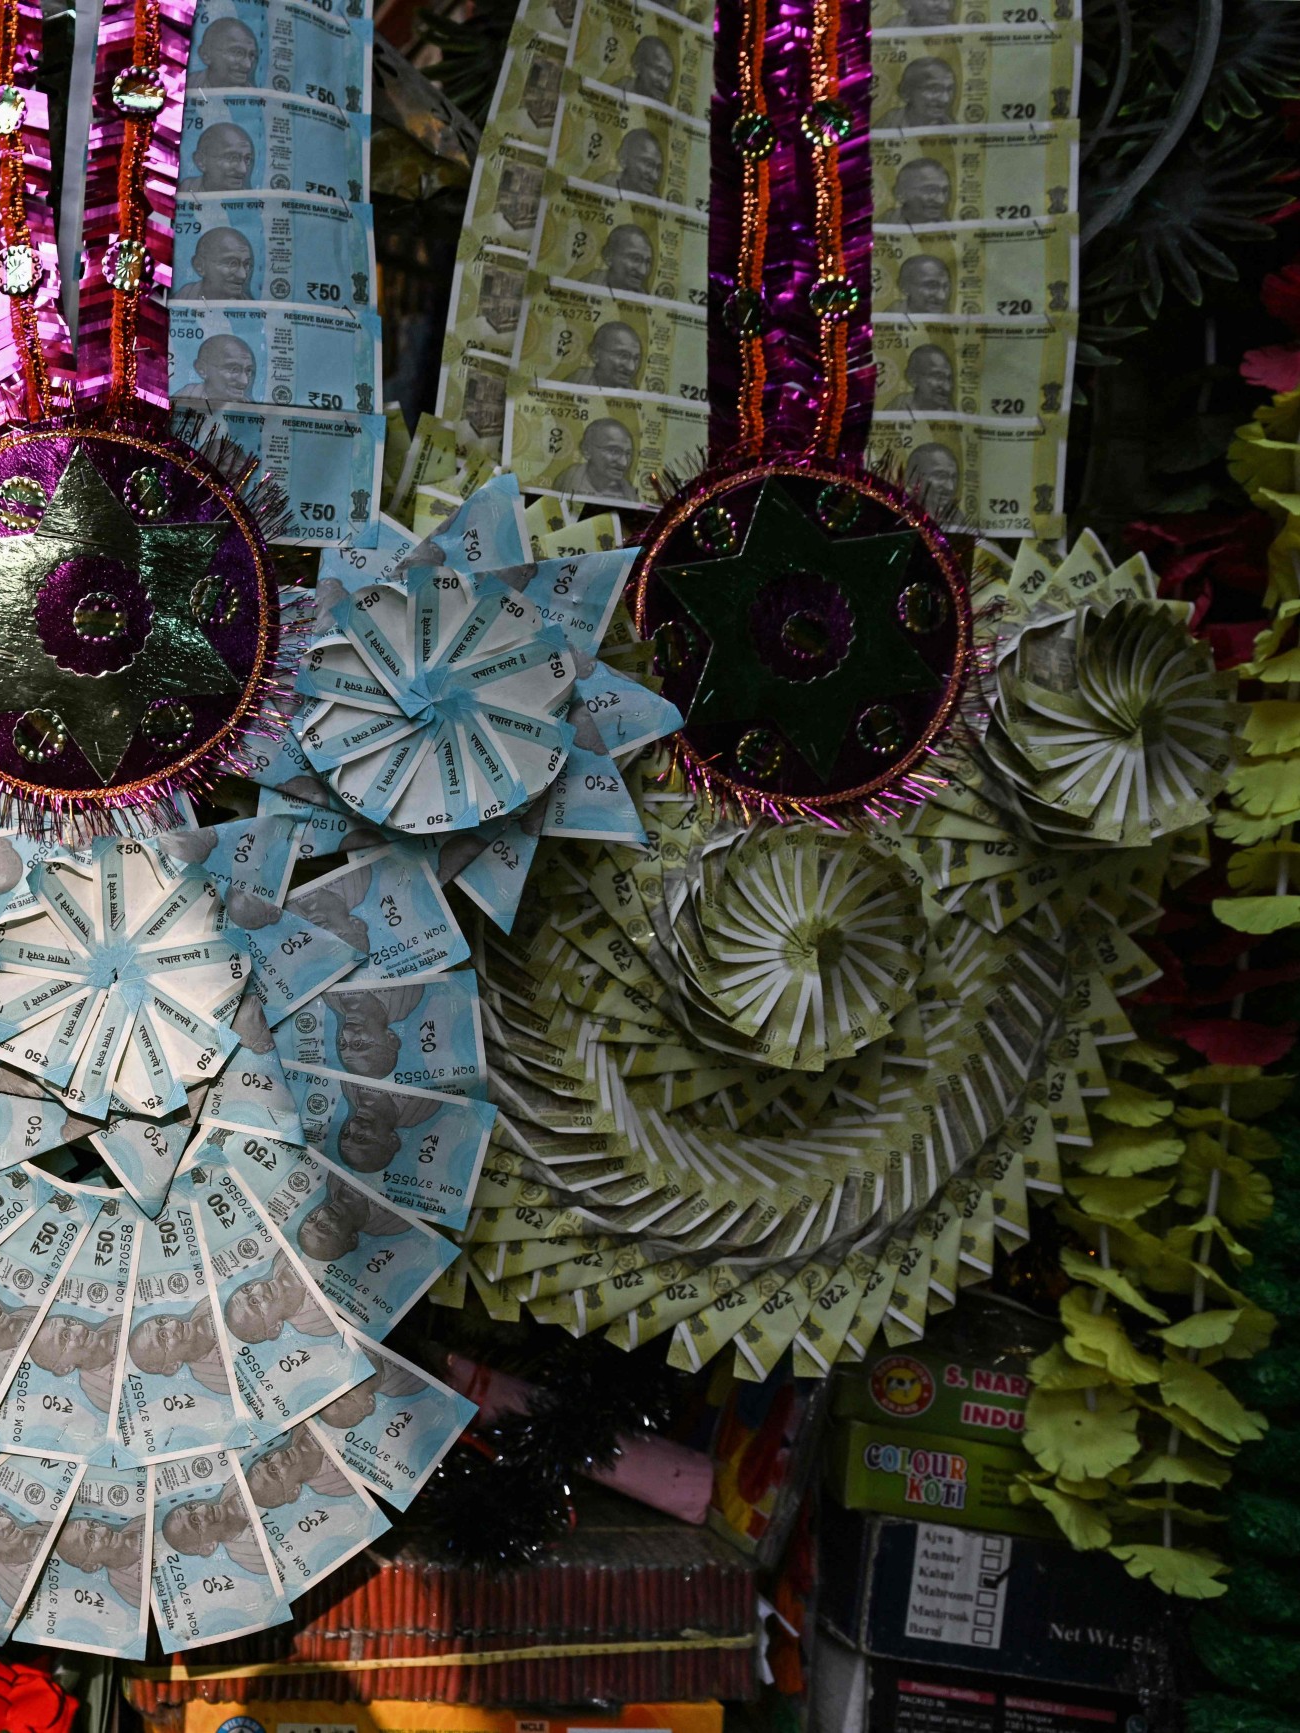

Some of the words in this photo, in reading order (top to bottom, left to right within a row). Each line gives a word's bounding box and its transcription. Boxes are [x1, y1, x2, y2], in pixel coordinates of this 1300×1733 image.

[1003, 7, 1038, 23] ₹20
[1002, 103, 1036, 120] ₹20
[282, 201, 311, 212] RESERVE
[312, 204, 329, 213] BANK
[307, 282, 340, 301] ₹50
[997, 299, 1032, 315] ₹20
[283, 312, 314, 323] RESERVE
[316, 315, 333, 325] BANK
[334, 318, 343, 327] OF
[344, 319, 362, 331] INDIA
[308, 391, 343, 411] ₹50
[990, 398, 1025, 415] ₹20
[544, 407, 589, 421] 263738
[282, 418, 313, 429] RESERVE
[315, 421, 332, 431] BANK
[300, 502, 336, 522] ₹50
[989, 498, 1019, 515] ₹20
[433, 576, 459, 591] ₹50
[1020, 570, 1047, 595] ₹20
[472, 665, 496, 680] पचास
[496, 656, 518, 672] रुपये
[116, 843, 142, 855] ₹50
[157, 952, 181, 966] पचास
[182, 949, 202, 962] रुपये
[370, 936, 419, 966] 370552
[393, 1068, 445, 1084] 370553
[382, 1170, 433, 1189] 370554
[158, 1221, 181, 1258] ₹50
[323, 1263, 371, 1296] 370555
[236, 1346, 275, 1392] 370556
[944, 1365, 968, 1387] S.
[17, 1361, 32, 1412] 370558
[128, 1374, 152, 1422] 370557
[344, 1430, 392, 1463] 370570
[864, 1443, 968, 1482] COLOUR
[905, 1475, 967, 1509] KOTI
[260, 1511, 297, 1561] 370571
[922, 1530, 954, 1546] Ajwa
[49, 1558, 61, 1607] 370573
[166, 1553, 193, 1606] 370572
[1049, 1622, 1081, 1644] Net
